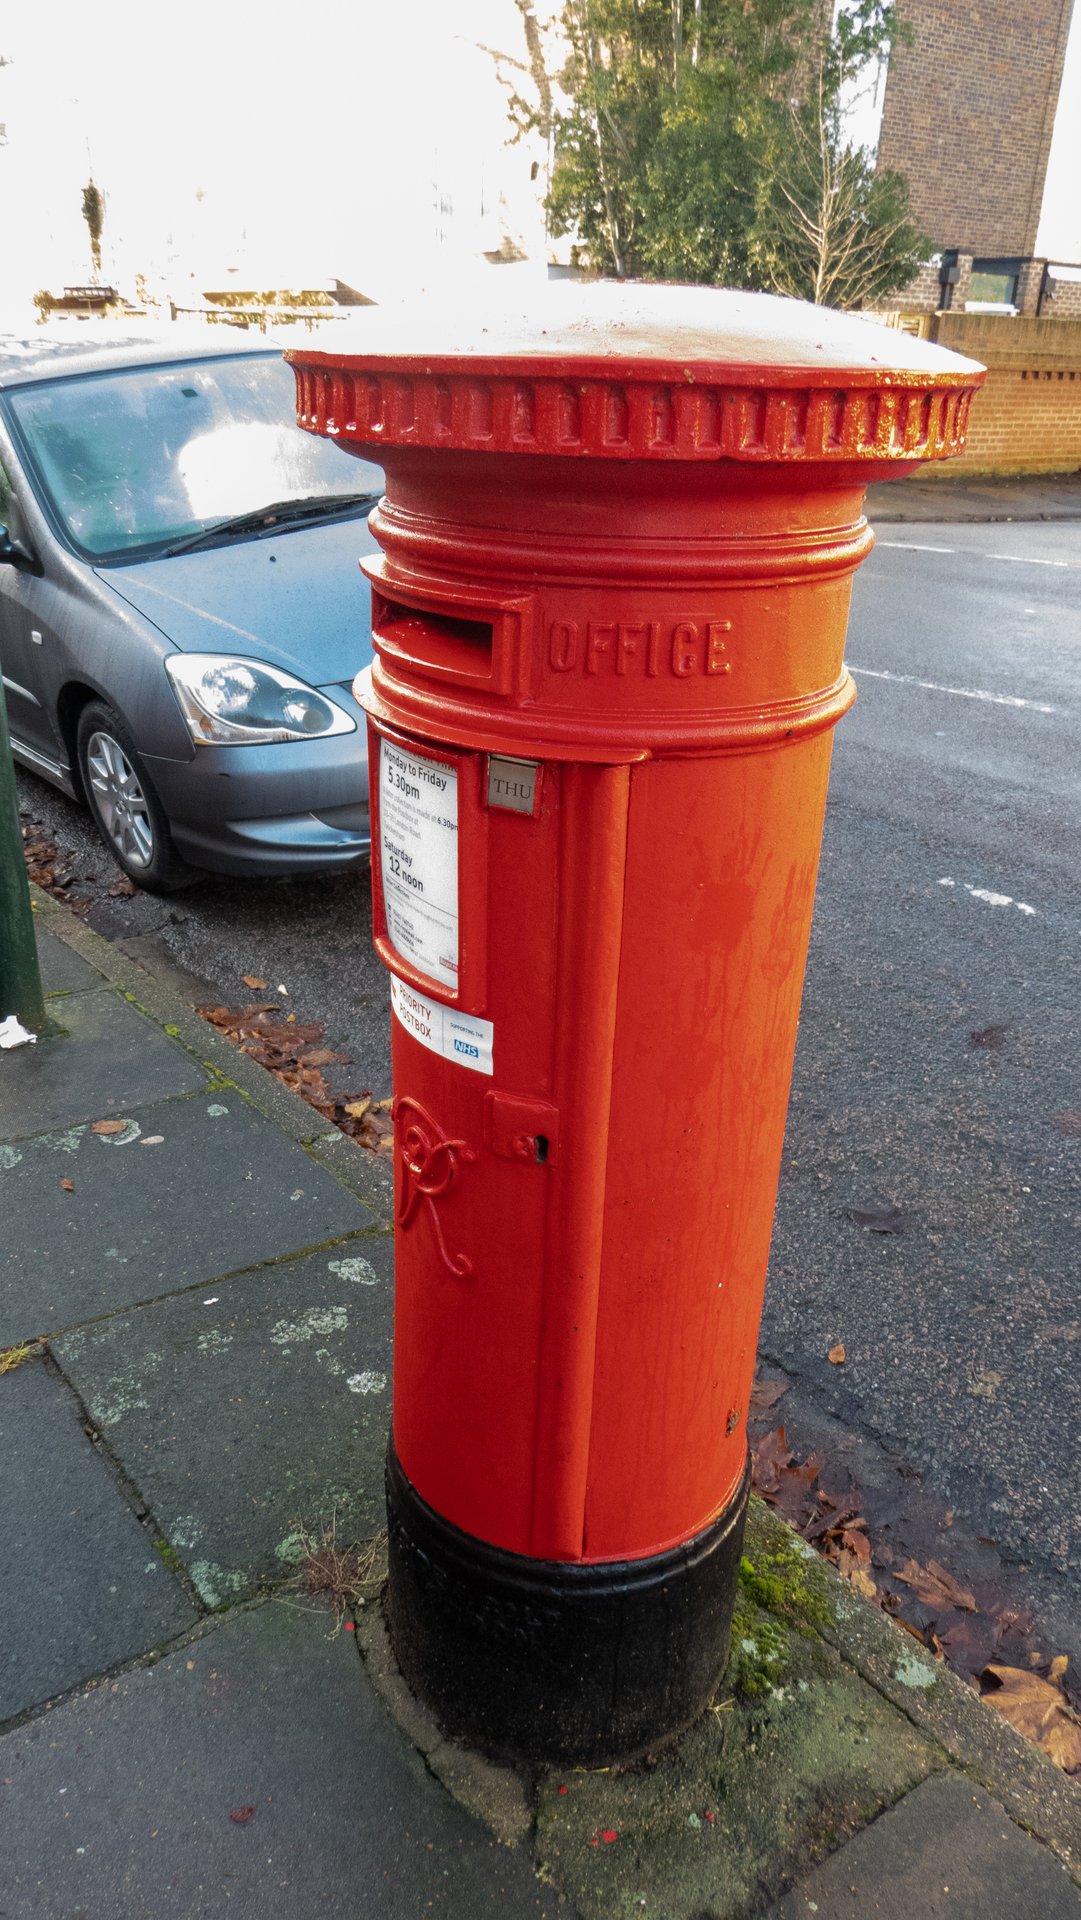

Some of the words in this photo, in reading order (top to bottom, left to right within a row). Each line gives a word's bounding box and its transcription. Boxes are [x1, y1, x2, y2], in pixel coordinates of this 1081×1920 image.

[550, 619, 732, 678] OFFICE
[384, 745, 407, 773] Monday
[408, 763, 417, 776] to
[418, 766, 447, 791] Friday
[388, 765, 420, 800] 5.30pm
[493, 778, 532, 799] THU
[384, 835, 413, 867] Saturday
[389, 855, 401, 877] 12
[402, 870, 424, 892] noon
[400, 984, 431, 1020] PRIORITY
[400, 1003, 431, 1040] POSTBOX
[450, 1022, 475, 1036] SUPPORTING
[475, 1031, 484, 1039] THE
[454, 1039, 478, 1057] NHS
